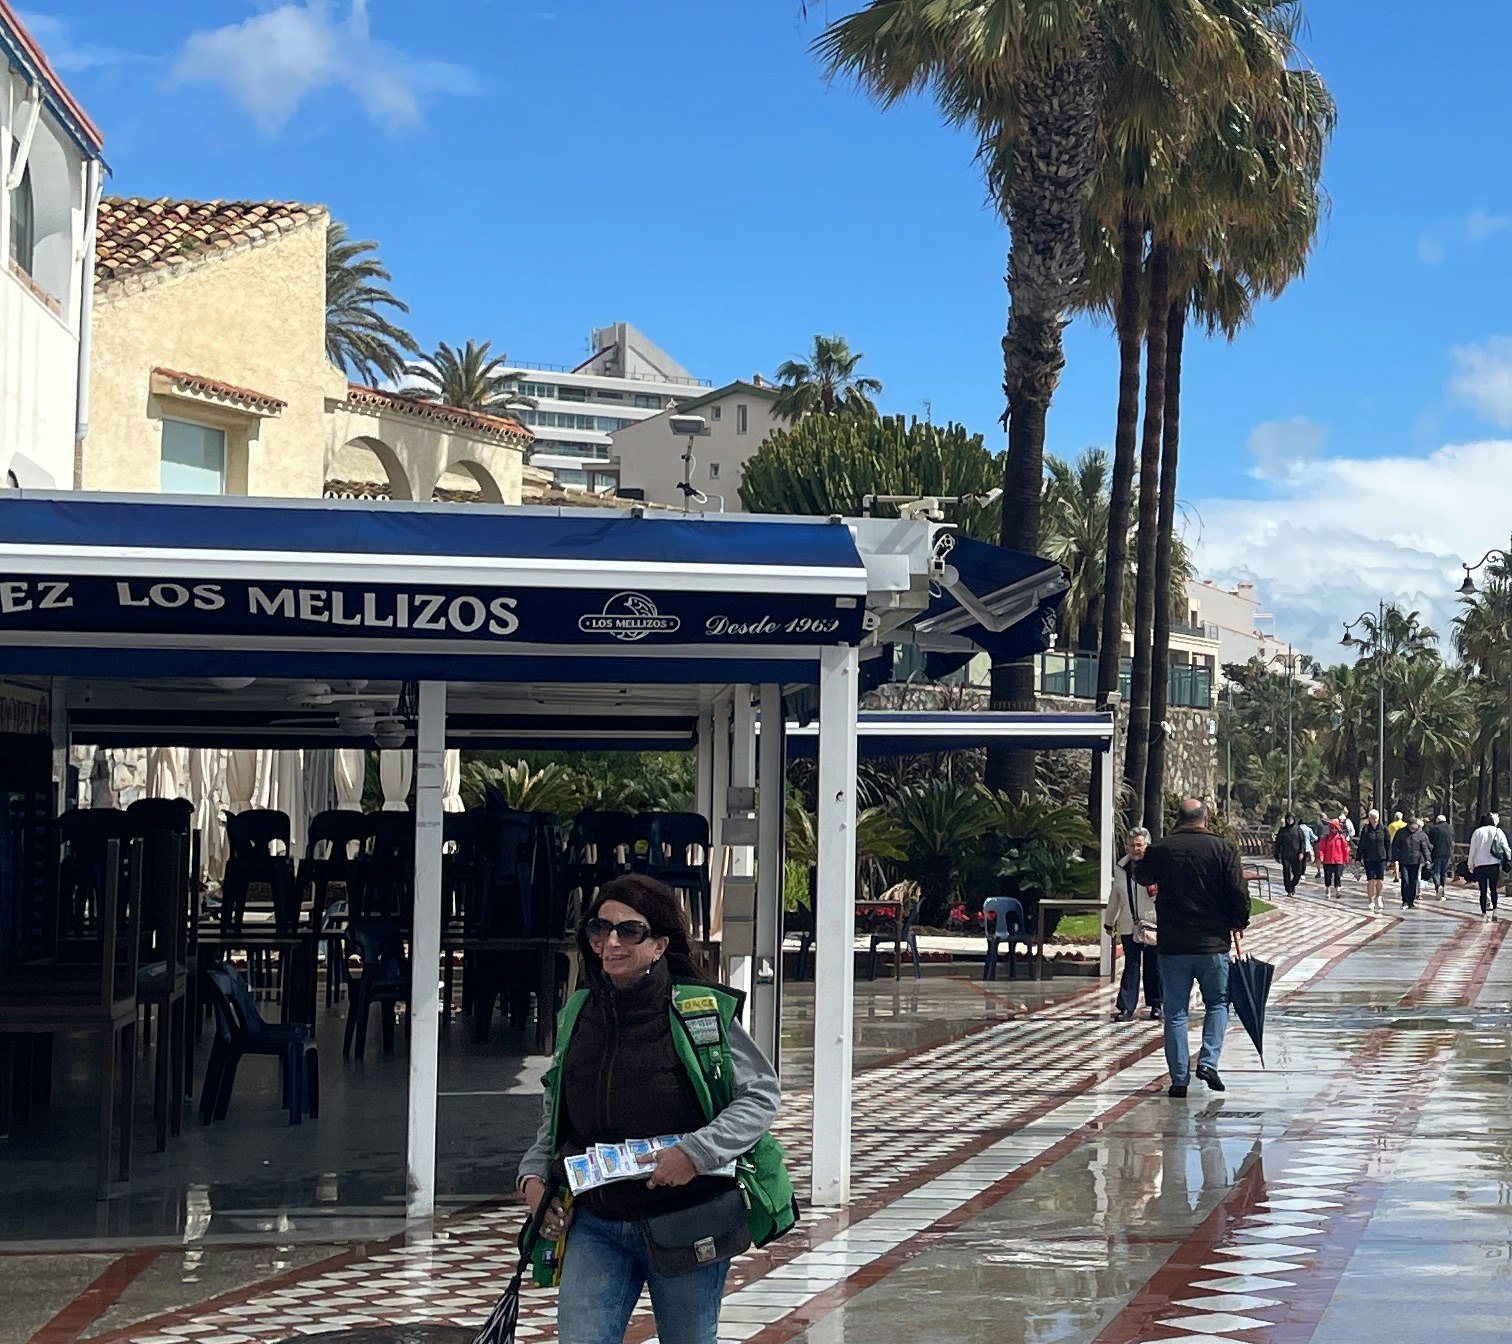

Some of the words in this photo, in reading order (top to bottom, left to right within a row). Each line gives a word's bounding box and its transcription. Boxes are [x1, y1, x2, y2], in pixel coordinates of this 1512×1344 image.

[116, 581, 226, 611] LOS
[247, 586, 519, 635] MELLIZOS
[592, 618, 613, 628] LOS
[615, 619, 668, 628] MELLIZOS
[705, 615, 781, 635] Desde
[784, 617, 840, 633] 1969
